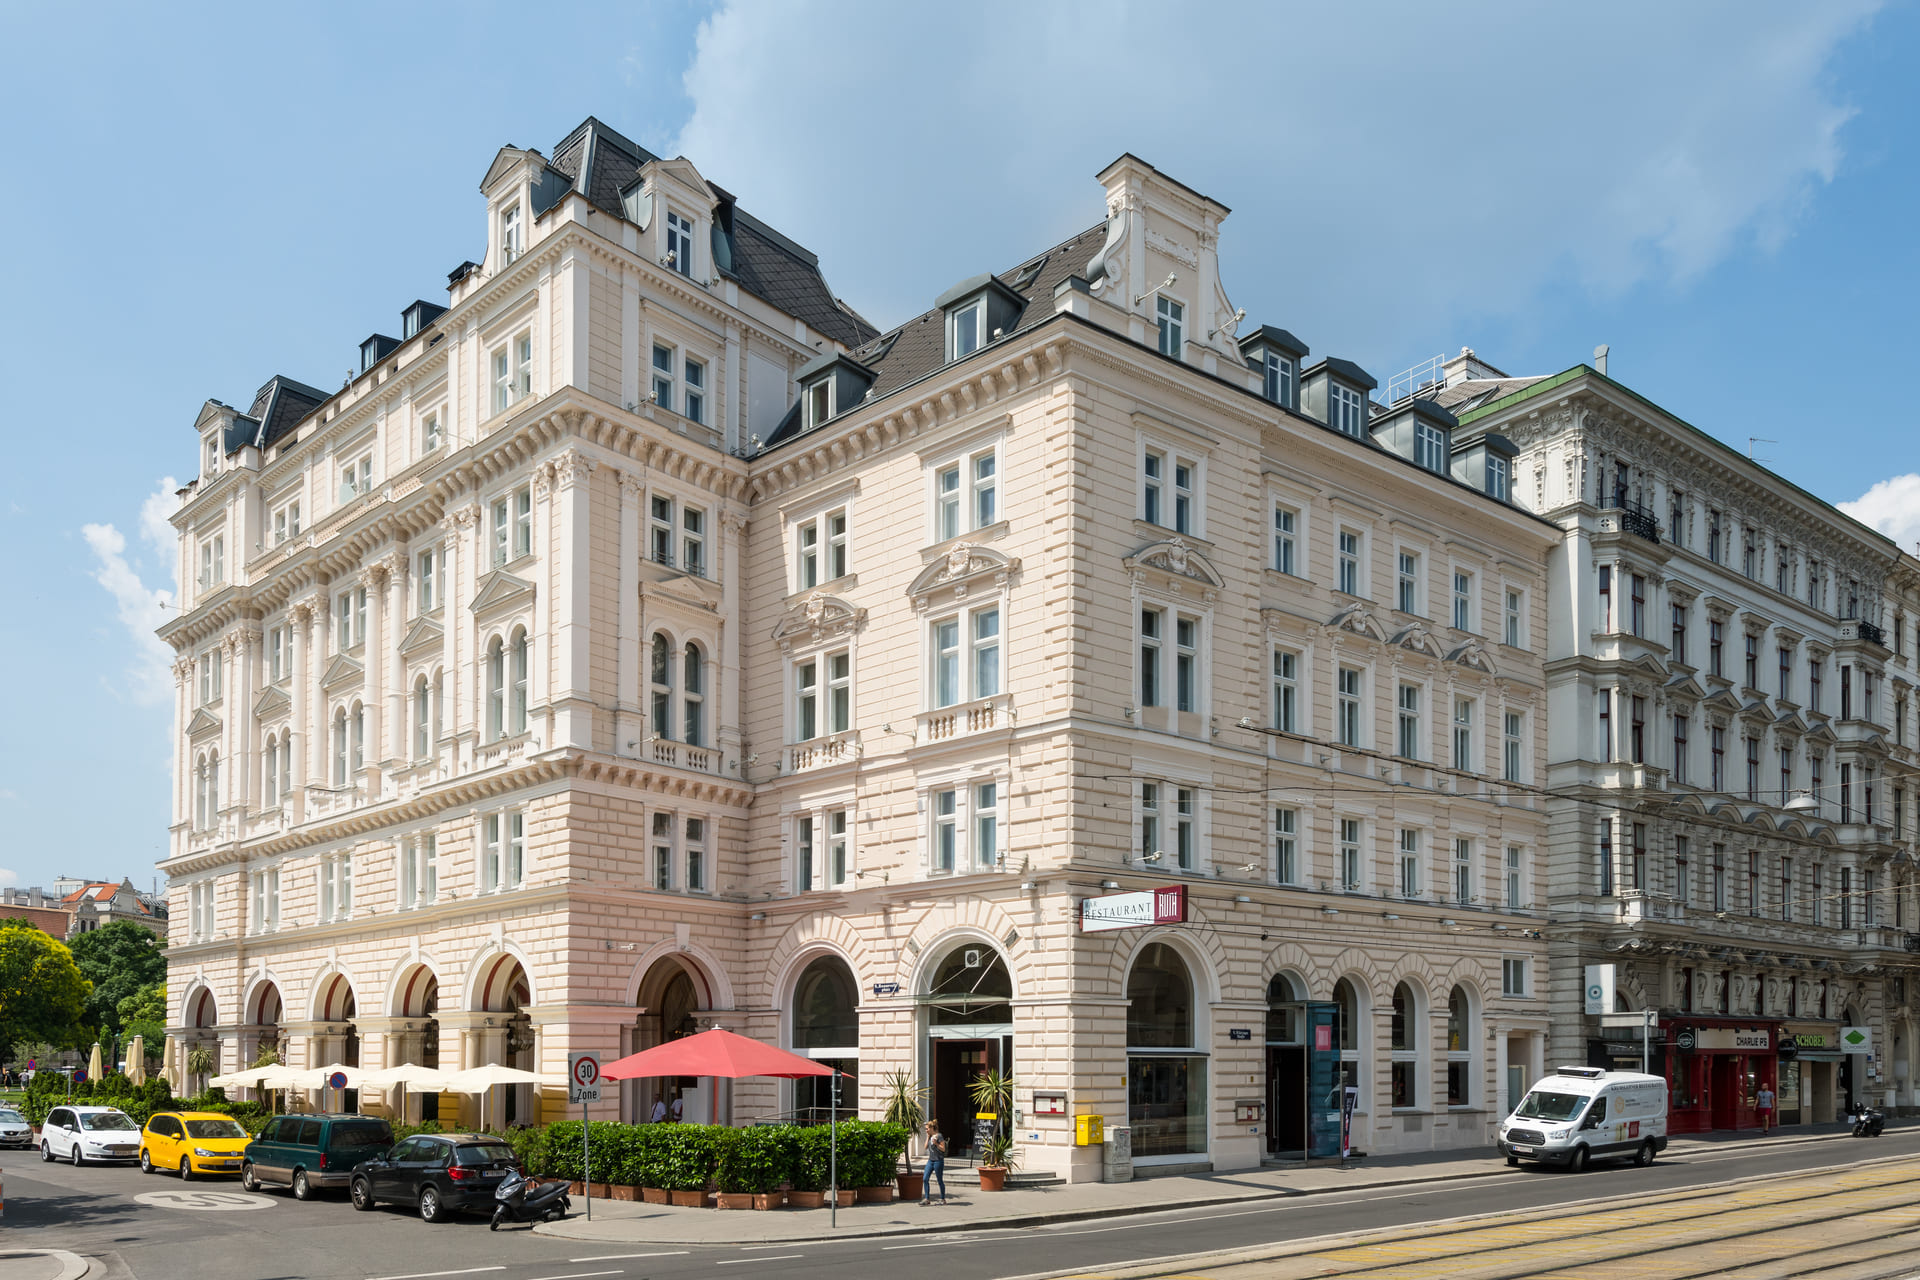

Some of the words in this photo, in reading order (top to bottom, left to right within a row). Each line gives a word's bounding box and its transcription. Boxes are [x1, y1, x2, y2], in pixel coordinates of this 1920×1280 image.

[1085, 902, 1152, 920] RESTAURANT
[1158, 892, 1177, 918] RUTH
[1736, 1036, 1759, 1047] CHARLIE
[1795, 1034, 1826, 1047] SCHOBER
[580, 1064, 593, 1079] 30
[577, 1088, 598, 1102] Zone
[149, 1193, 257, 1207] 30
